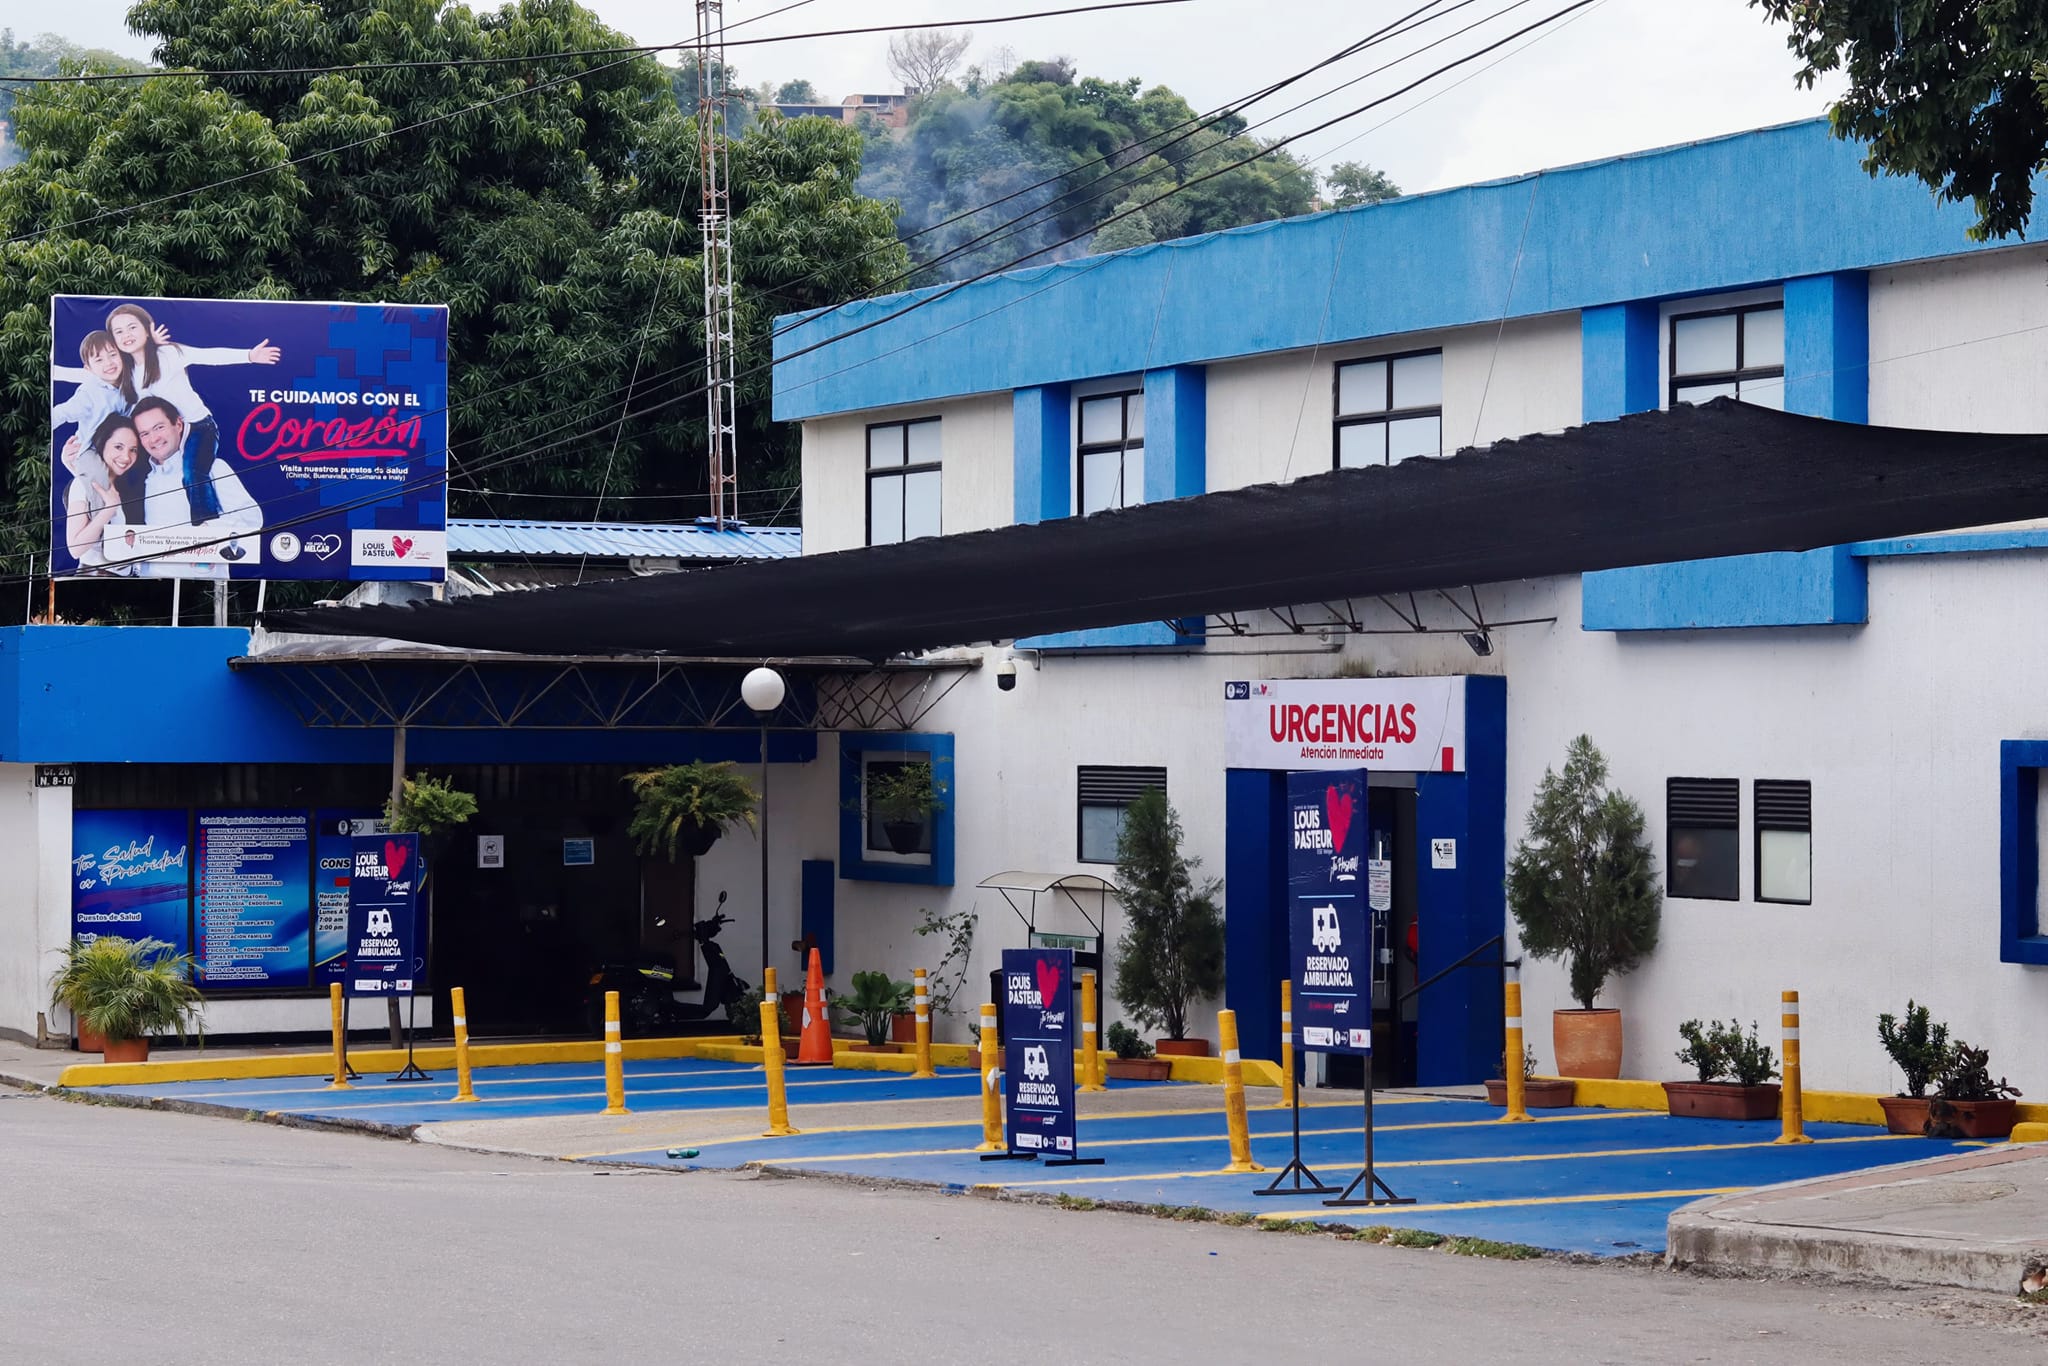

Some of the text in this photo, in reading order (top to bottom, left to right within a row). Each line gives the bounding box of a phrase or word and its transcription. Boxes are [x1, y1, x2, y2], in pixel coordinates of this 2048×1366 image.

[249, 390, 420, 406] TE CUIDAMOS CON EL
[237, 402, 422, 461] Corazón
[280, 464, 302, 472] Visita
[341, 466, 372, 476] puestos
[386, 466, 408, 474] Salud
[362, 542, 385, 550] LOUIS
[1270, 703, 1417, 743] URGENCIAS
[1300, 745, 1384, 760] Atención Inmediata
[40, 776, 74, 785] N. 8-10
[1294, 810, 1320, 829] LOUIS
[1294, 829, 1333, 849] PASTEUR
[102, 835, 154, 864] Salud
[98, 845, 186, 886] Prioridad
[355, 855, 378, 866] LOUIS
[355, 865, 389, 878] PASTEUR
[78, 913, 141, 922] Puestos de Salud
[360, 938, 399, 947] RESERVADO
[357, 947, 401, 956] AMBULANCIA
[1306, 956, 1349, 971] RESERVADO
[1008, 975, 1031, 990] LOUIS
[1303, 972, 1353, 987] AMBULANCIA
[1008, 990, 1042, 1005] PASTEUR
[1019, 1082, 1056, 1094] RESERVADO
[1016, 1093, 1060, 1106] AMBULANCIA
